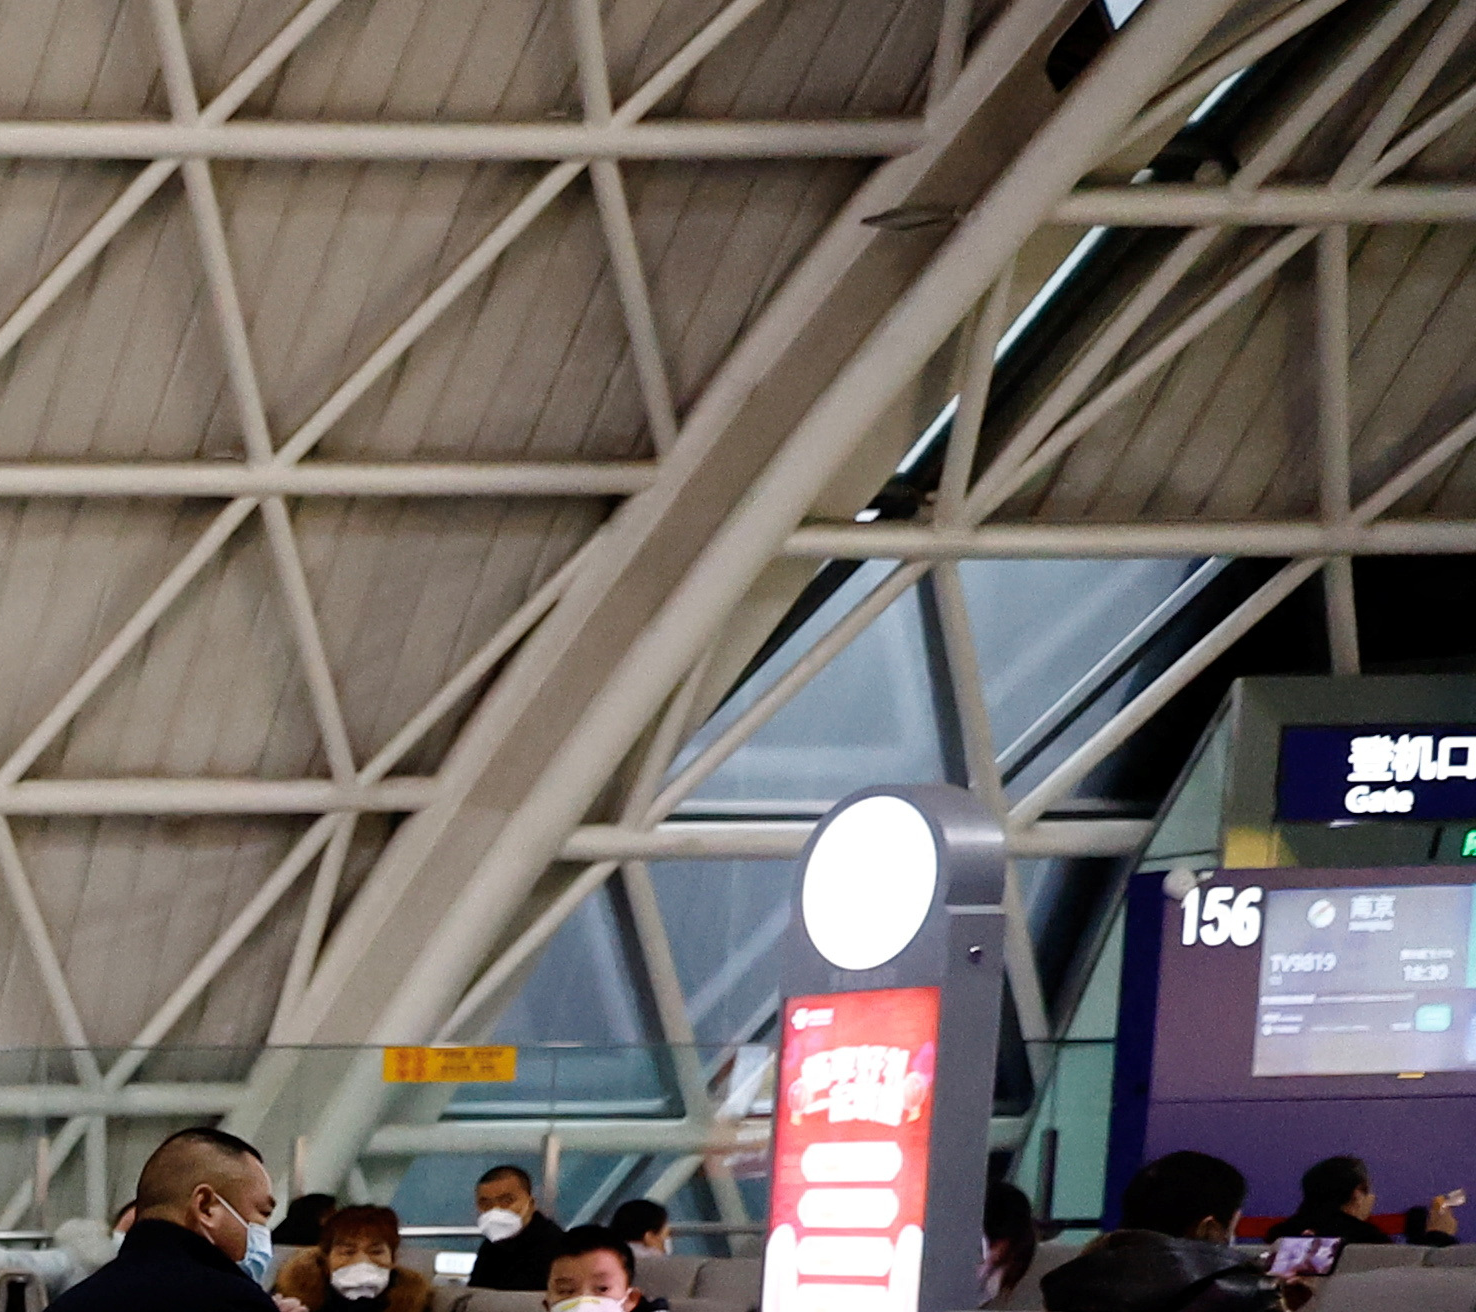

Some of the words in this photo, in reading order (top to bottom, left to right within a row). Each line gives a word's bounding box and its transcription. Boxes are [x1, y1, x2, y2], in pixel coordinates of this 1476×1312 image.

[1347, 734, 1476, 783] 登机口
[1344, 785, 1414, 814] Gate
[1181, 886, 1263, 947] 156
